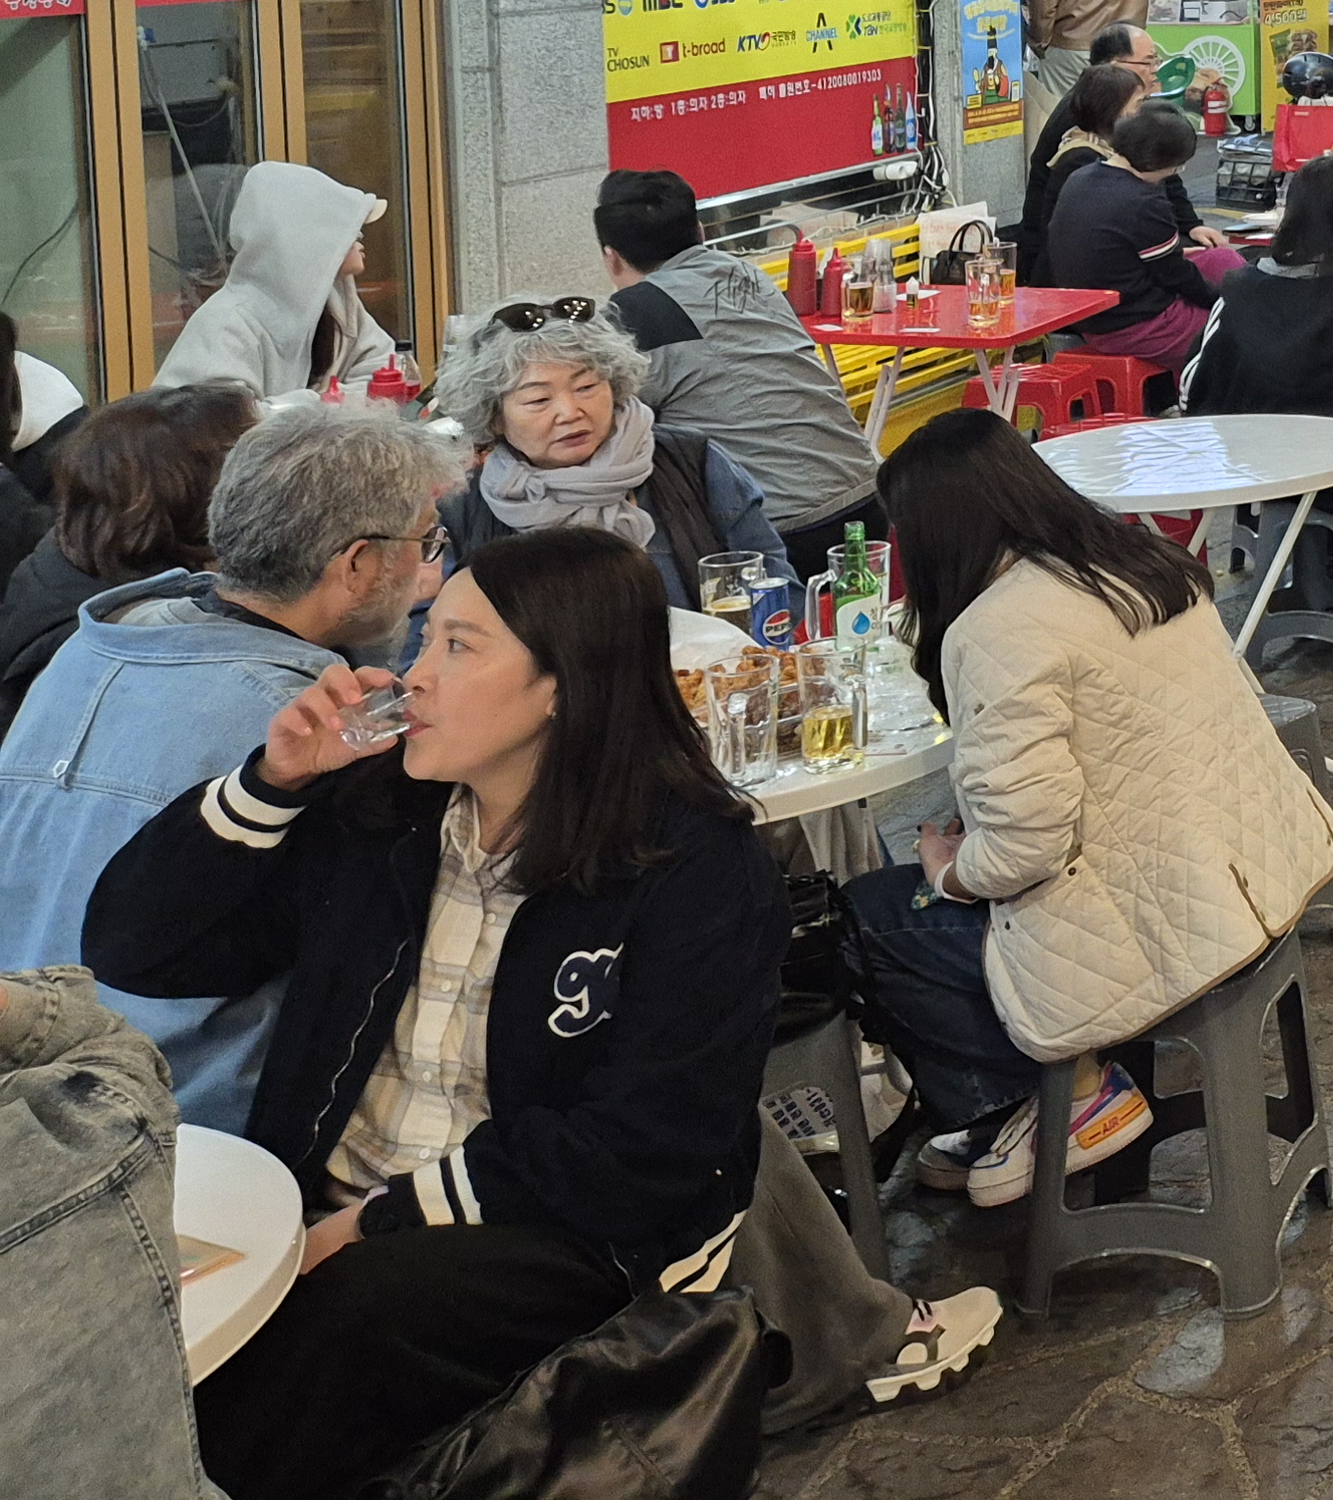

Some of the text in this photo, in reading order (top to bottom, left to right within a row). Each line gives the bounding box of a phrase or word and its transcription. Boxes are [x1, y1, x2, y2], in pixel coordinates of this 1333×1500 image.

[1265, 9, 1307, 26] 4,500원
[806, 26, 840, 42] CHANNEL
[682, 37, 726, 59] t-broad
[737, 33, 763, 53] KTV
[607, 47, 618, 58] TV
[607, 55, 650, 73] CHOSUN
